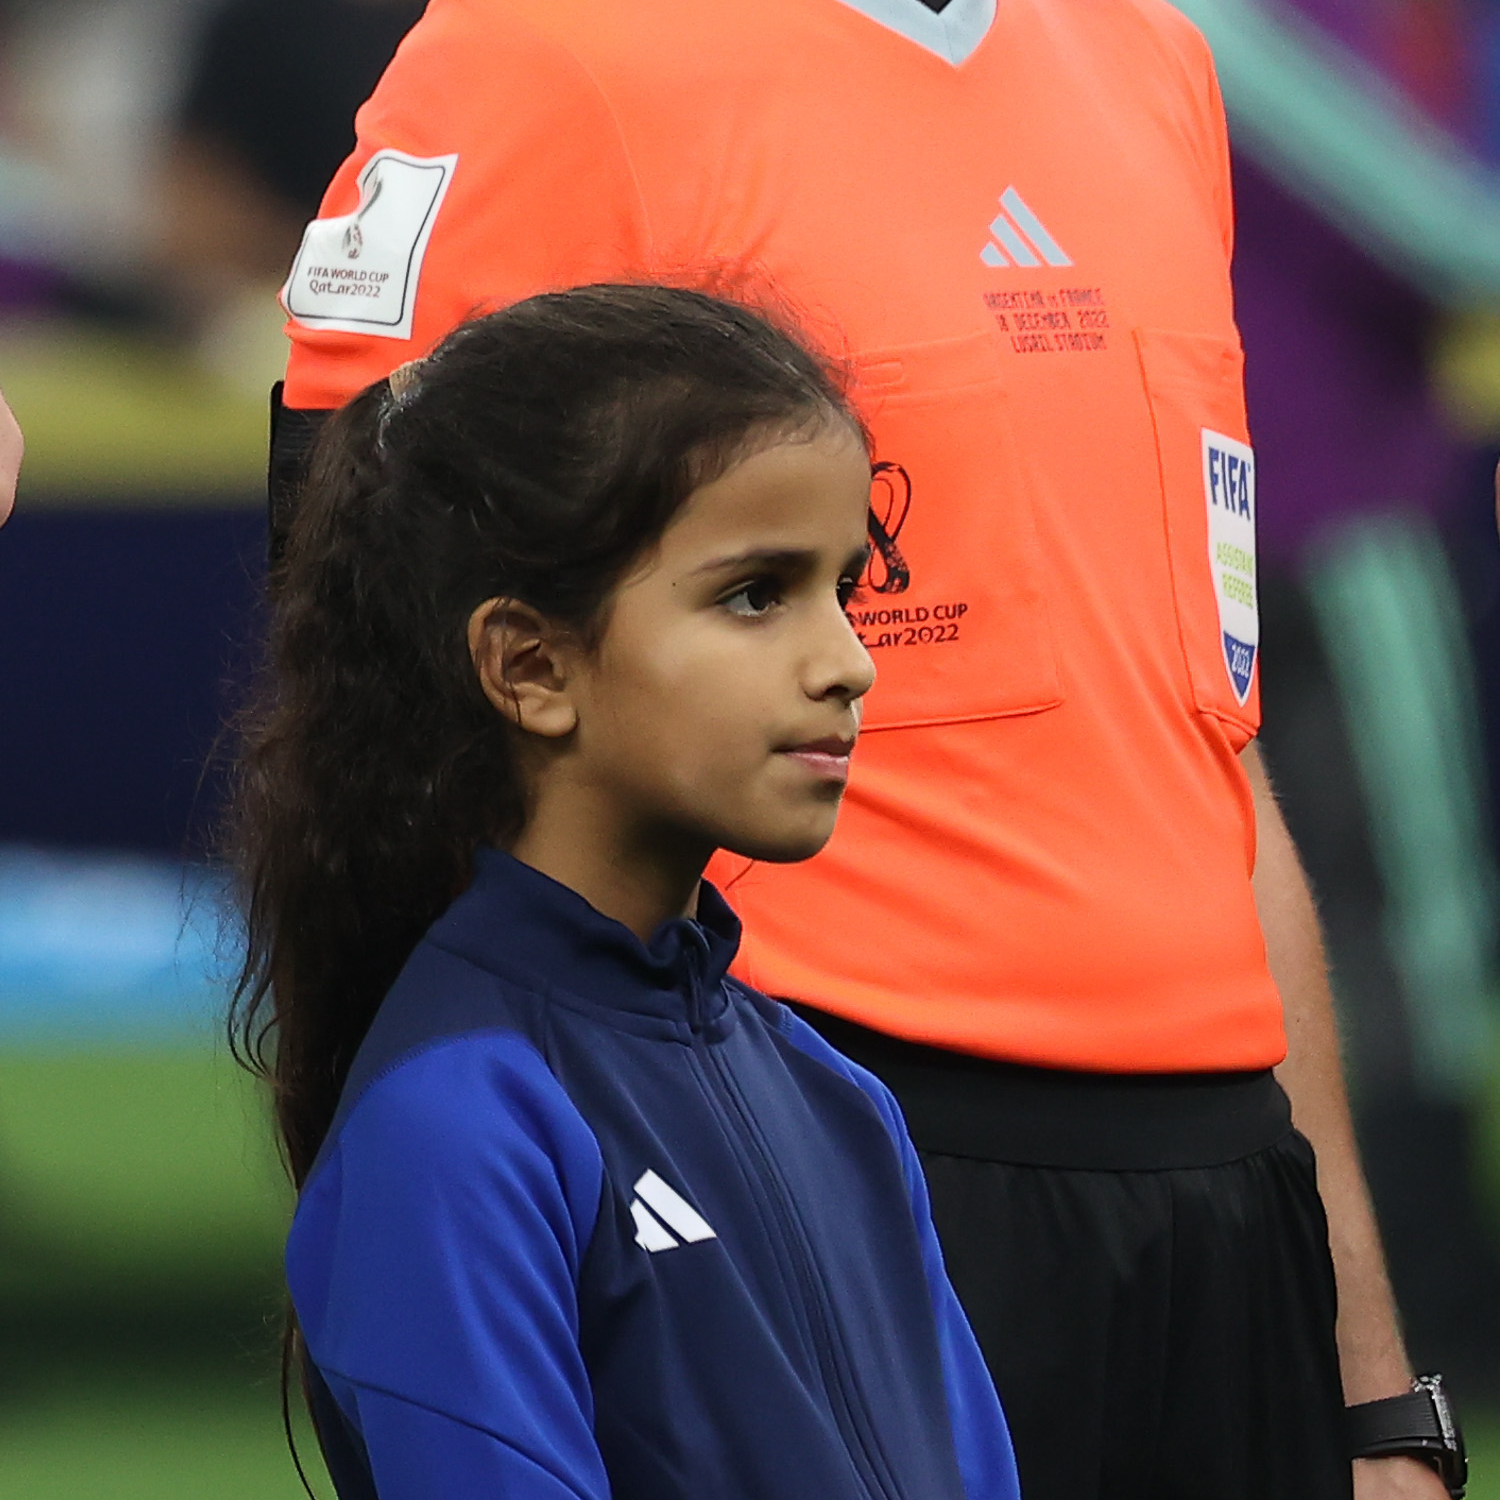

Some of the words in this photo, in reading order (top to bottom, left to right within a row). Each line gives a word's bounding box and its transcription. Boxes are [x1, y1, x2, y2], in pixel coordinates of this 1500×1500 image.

[308, 266, 330, 278] FIFA
[330, 268, 366, 281] WORLD
[368, 271, 390, 283] CUP
[1013, 312, 1071, 331] DECEMBER
[1077, 310, 1110, 329] 2022
[1054, 332, 1107, 351] STADIUM
[1208, 446, 1251, 522] FIFA
[859, 606, 929, 626] WORLD
[933, 603, 968, 621] CUP
